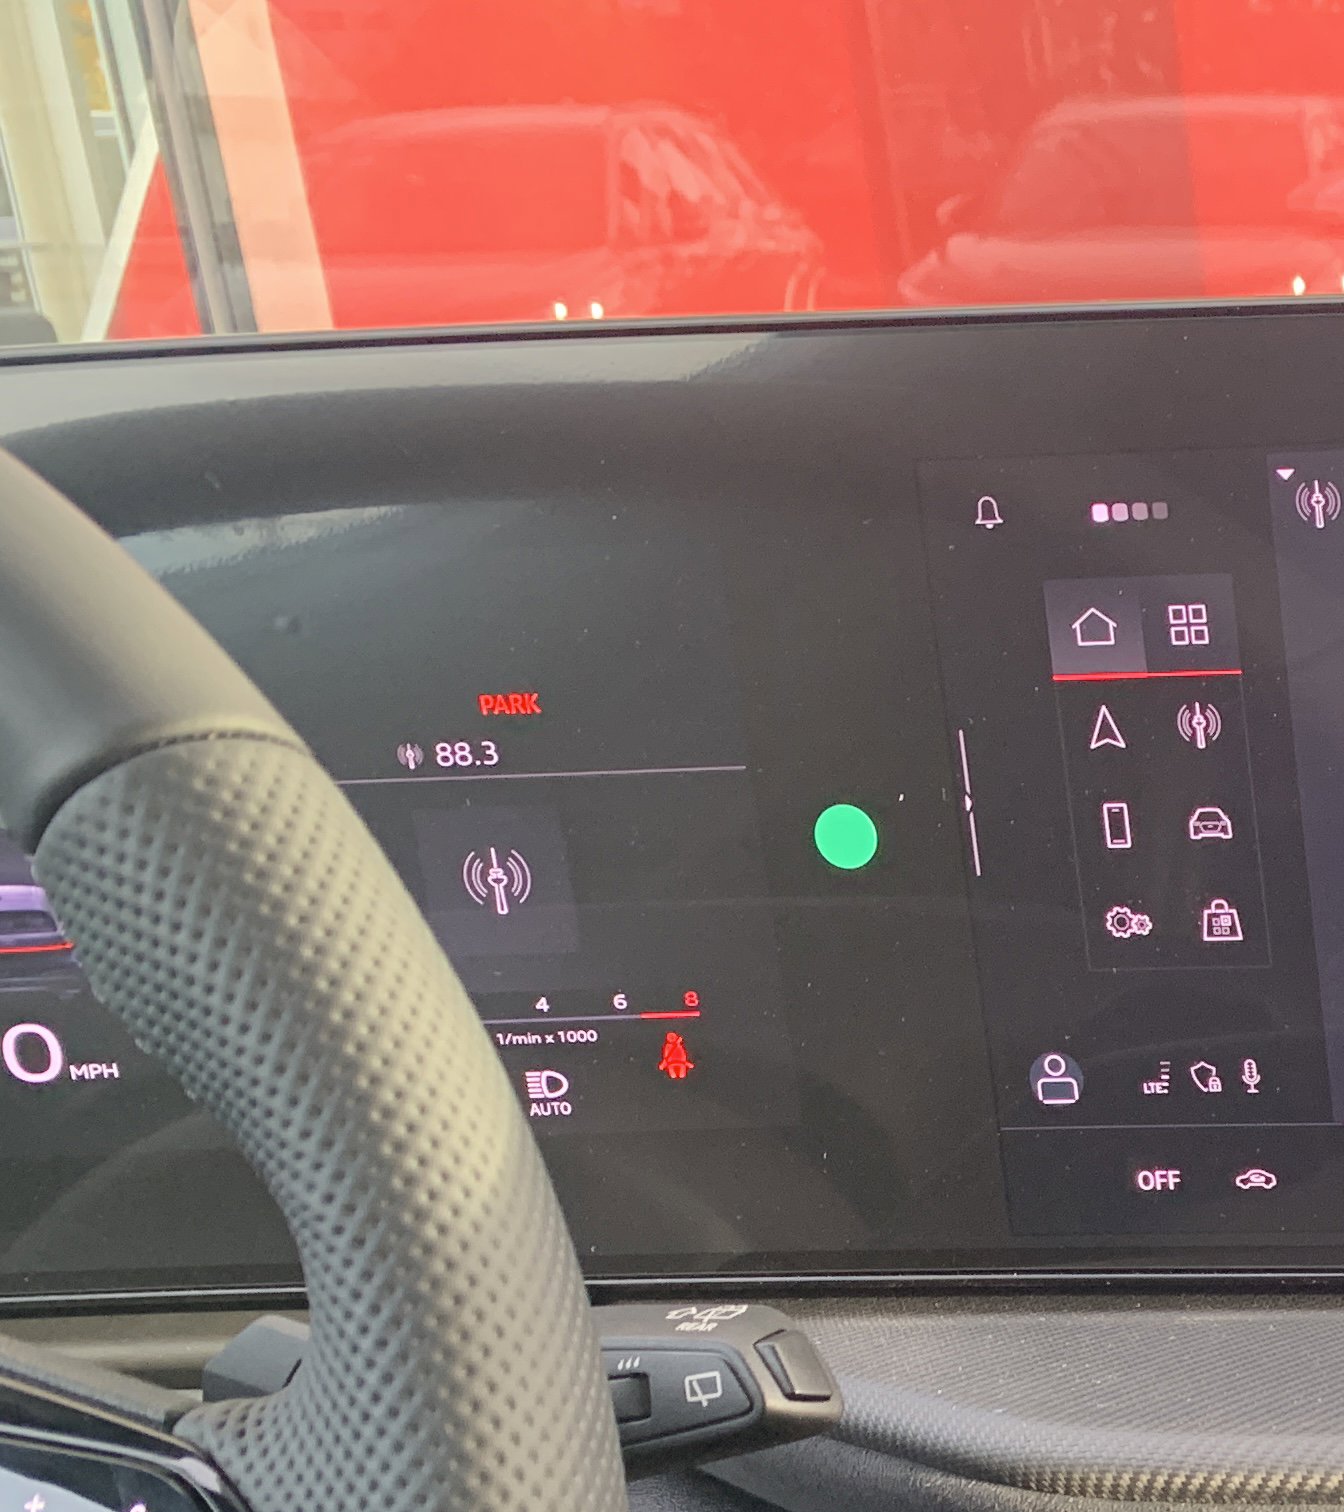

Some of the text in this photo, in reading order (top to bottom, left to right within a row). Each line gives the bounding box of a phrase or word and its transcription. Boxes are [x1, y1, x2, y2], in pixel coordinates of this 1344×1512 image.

[478, 692, 542, 716] PARK
[435, 741, 499, 767] 88.3
[535, 997, 549, 1012] 4
[613, 994, 628, 1010] 6
[684, 991, 699, 1007] 8
[496, 1029, 598, 1047] 1/min x 1000
[1, 1023, 120, 1083] 0 MPH
[529, 1101, 572, 1117] AUTO
[1137, 1169, 1181, 1191] OFF
